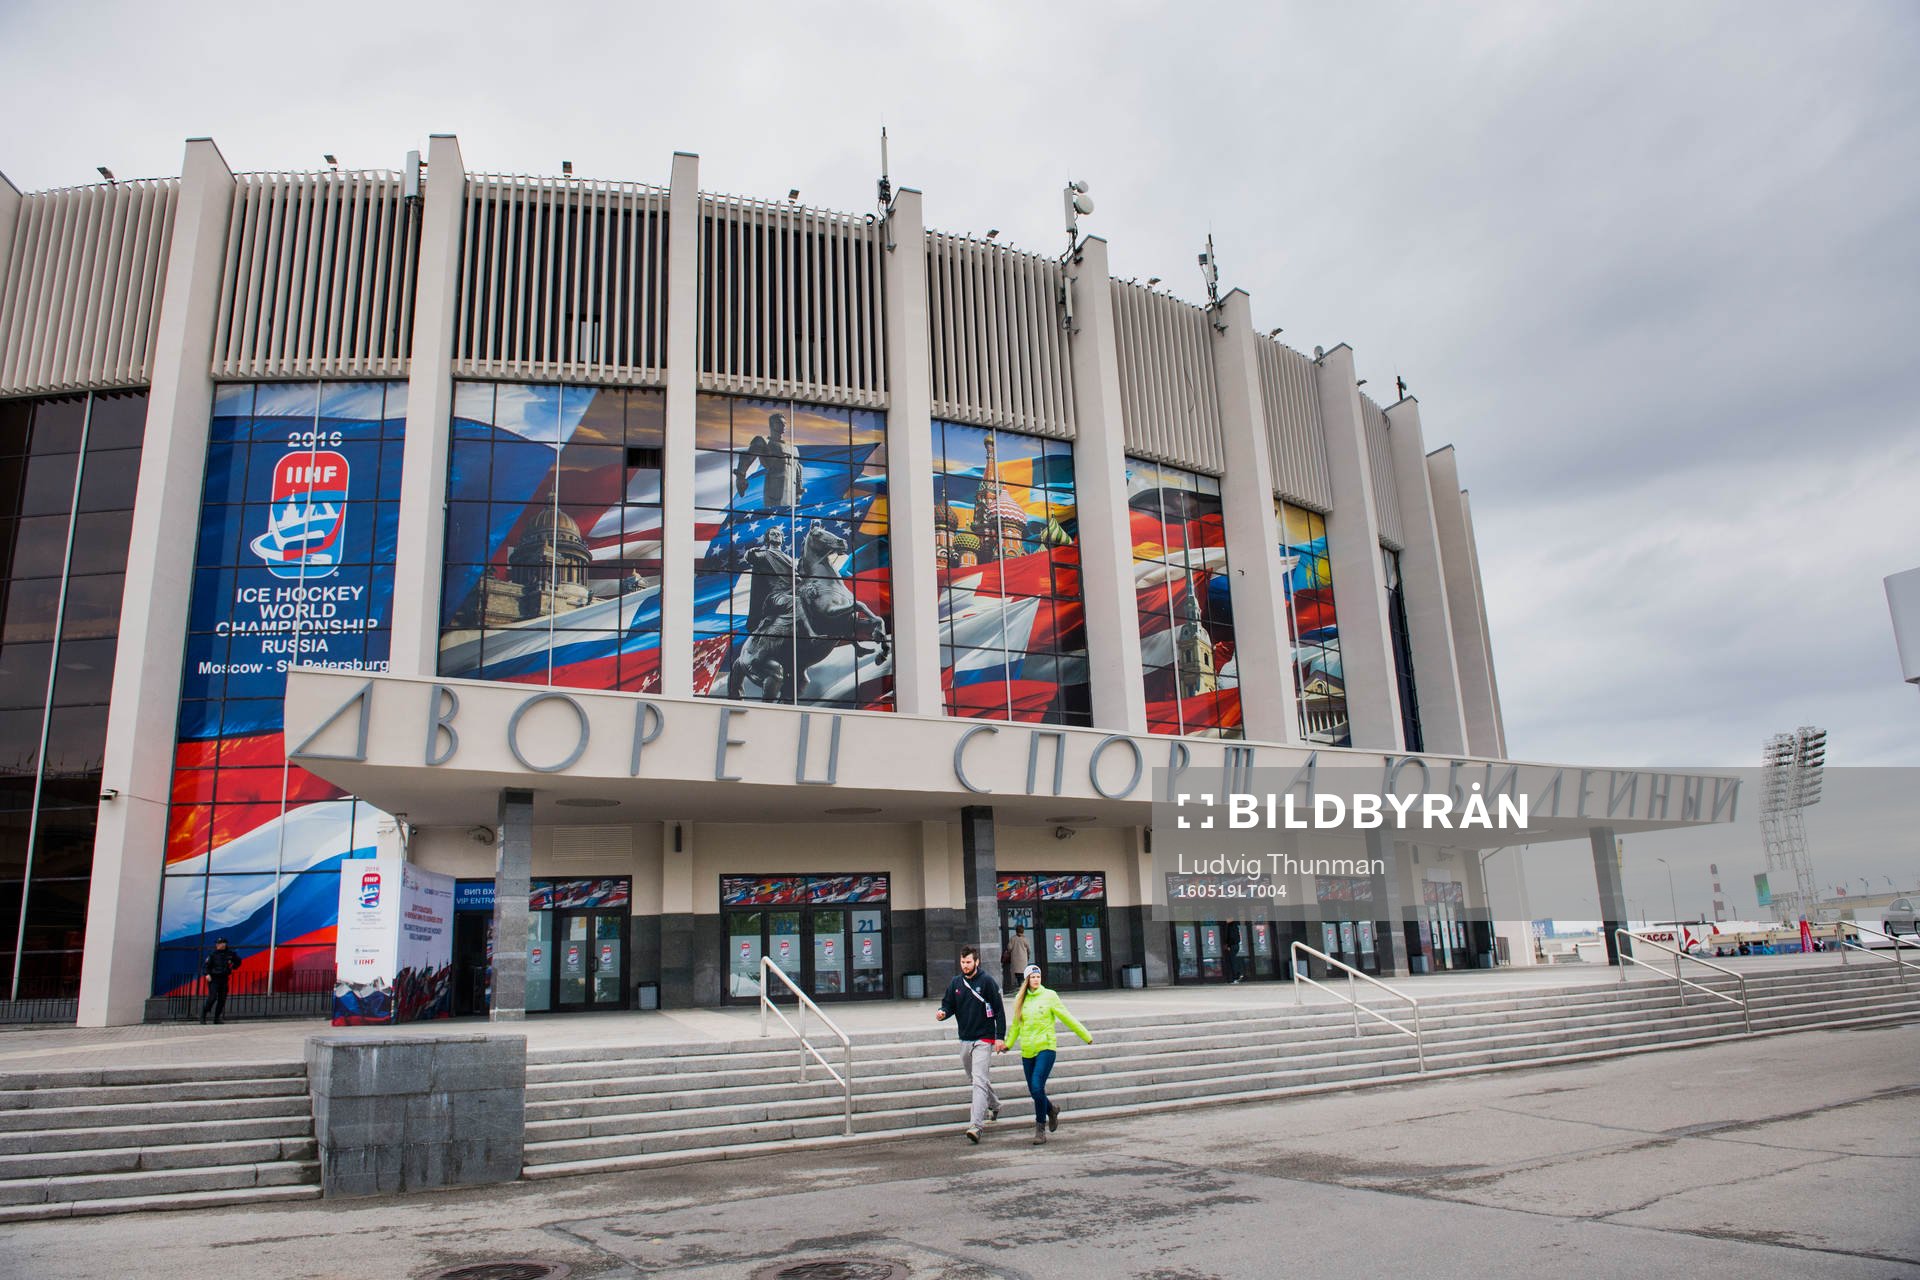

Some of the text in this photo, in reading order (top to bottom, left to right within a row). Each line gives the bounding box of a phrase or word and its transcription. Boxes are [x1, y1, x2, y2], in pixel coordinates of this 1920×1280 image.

[287, 431, 343, 448] 2016
[286, 465, 337, 483] IIHF
[236, 586, 364, 603] ICE HOCKEY
[260, 603, 336, 619] WORLD
[215, 618, 378, 637] CHAMPIONSHIP
[261, 638, 329, 654] RUSSIA
[198, 661, 264, 675] Moscow
[303, 658, 390, 673] Petersburg
[288, 679, 842, 785] ДВОРЕЦ
[952, 724, 1319, 807] СПОРТА
[858, 919, 874, 933] 21
[1081, 914, 1095, 927] 19
